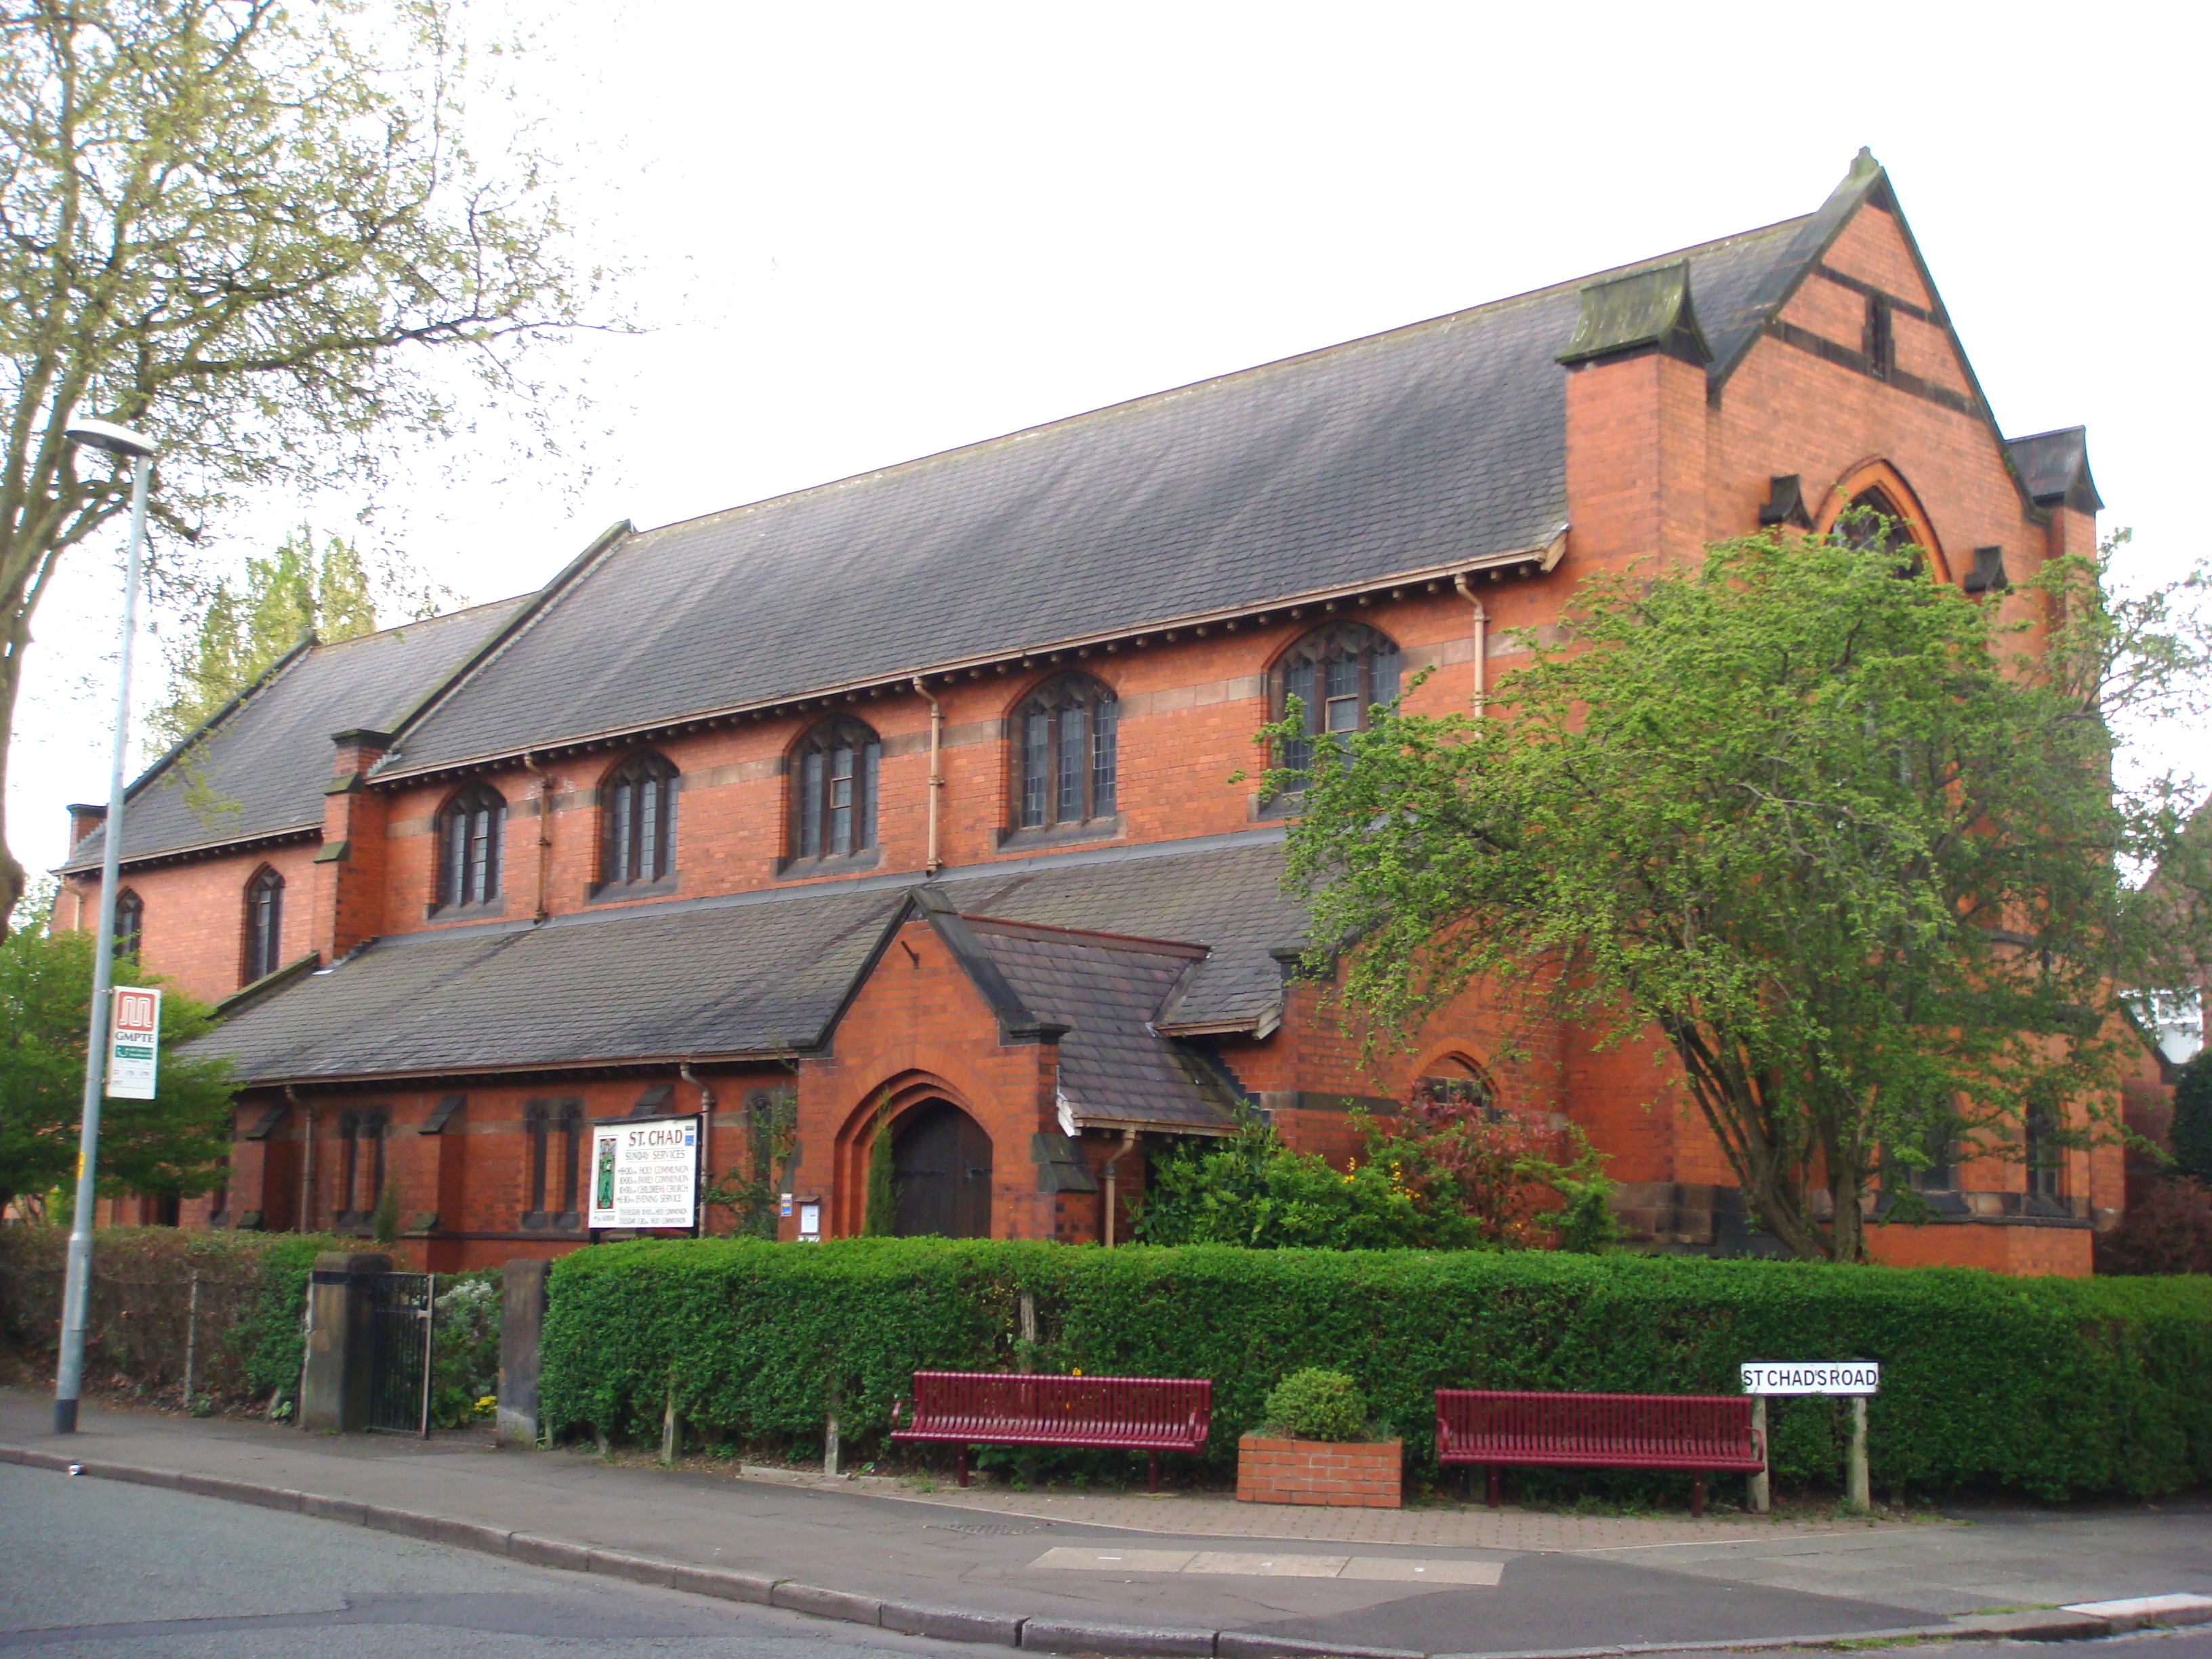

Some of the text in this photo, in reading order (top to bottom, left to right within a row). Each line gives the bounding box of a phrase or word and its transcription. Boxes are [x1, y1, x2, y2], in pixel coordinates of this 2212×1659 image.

[115, 1031, 154, 1043] GMPTE
[629, 1131, 646, 1147] ST.
[649, 1130, 682, 1145] CHAD
[626, 1150, 685, 1160] SUNDAY SERVICES
[1744, 1370, 1877, 1386] ST CHAD'S ROAD
